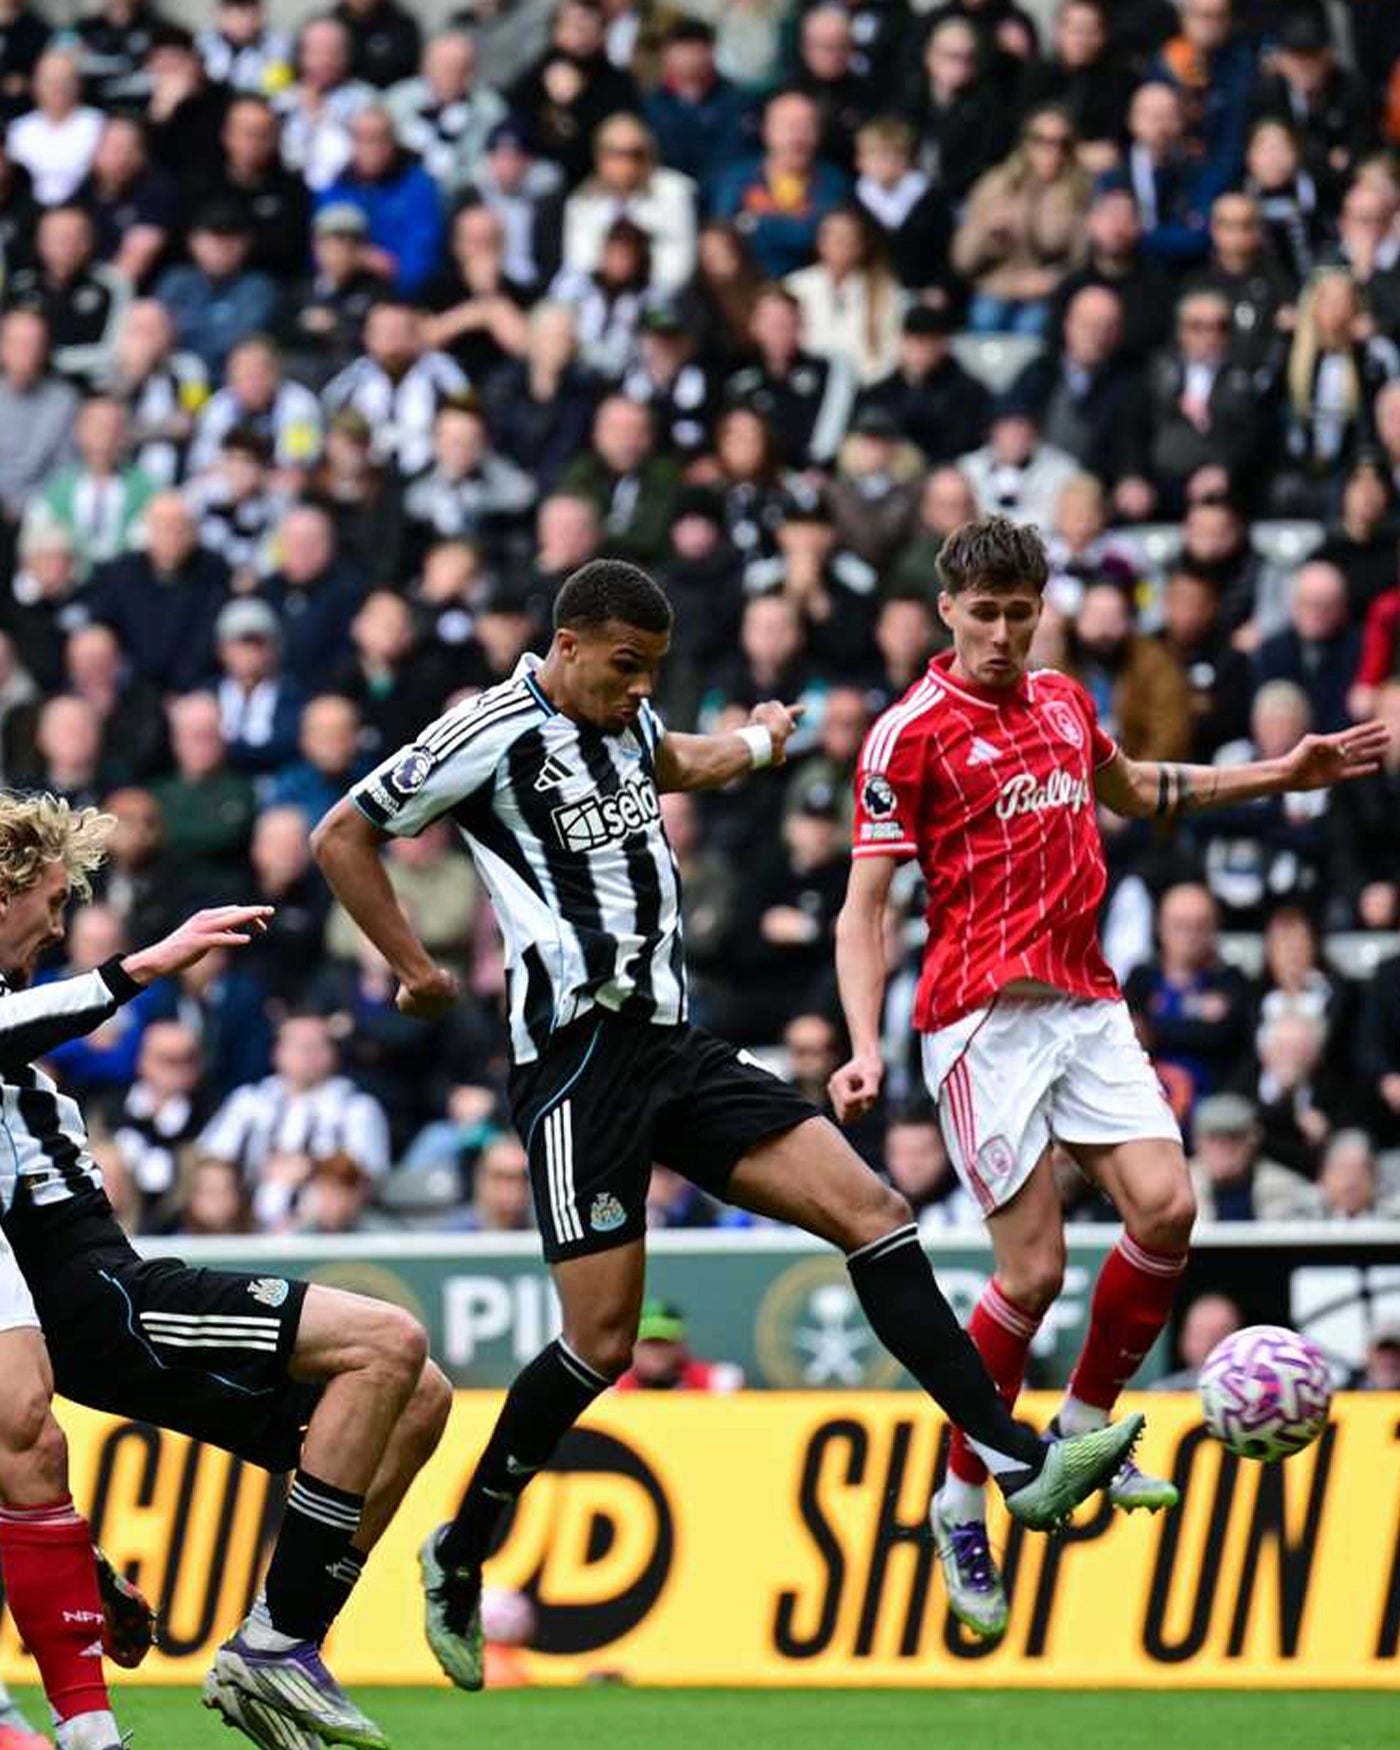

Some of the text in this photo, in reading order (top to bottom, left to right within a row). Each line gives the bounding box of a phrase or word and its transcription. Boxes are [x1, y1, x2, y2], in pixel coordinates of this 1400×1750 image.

[443, 1274, 564, 1367] PI
[481, 1471, 659, 1606] JD
[1142, 1422, 1338, 1660] ON
